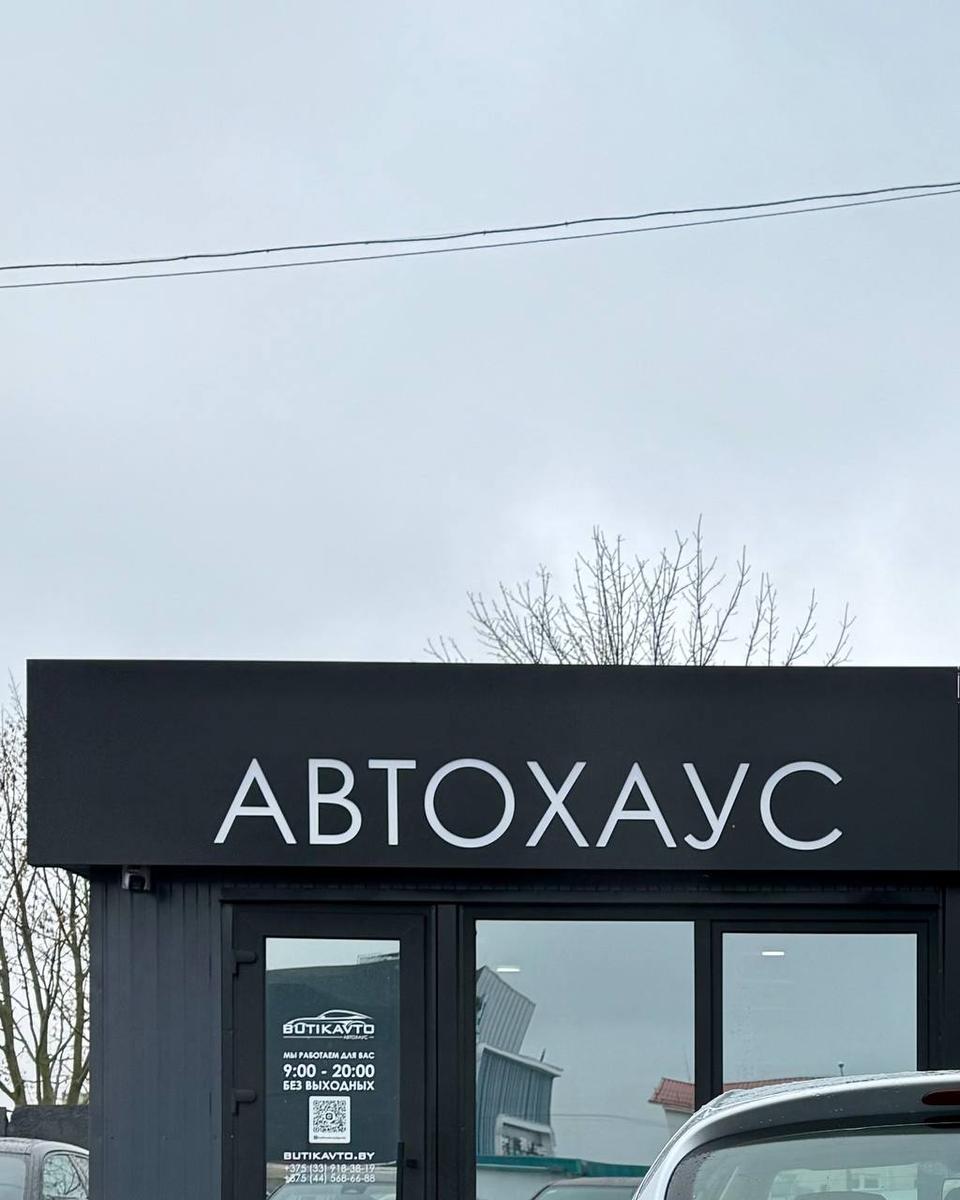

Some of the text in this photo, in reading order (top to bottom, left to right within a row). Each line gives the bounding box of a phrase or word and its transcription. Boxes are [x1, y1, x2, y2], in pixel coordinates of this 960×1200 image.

[213, 758, 844, 851] АВТОХАУС
[283, 1023, 375, 1034] BUTIKAVTO
[340, 1052, 357, 1060] ДЛЯ
[283, 1064, 317, 1078] 9:00
[332, 1064, 375, 1078] 20:00
[283, 1081, 375, 1092] БЕЗ ВЫХОДНЫХ
[283, 1152, 375, 1160] BUTIKAVTO.BY
[309, 1164, 327, 1174] (33)
[309, 1174, 327, 1184] (44)
[330, 1174, 376, 1183] 568-66-88
